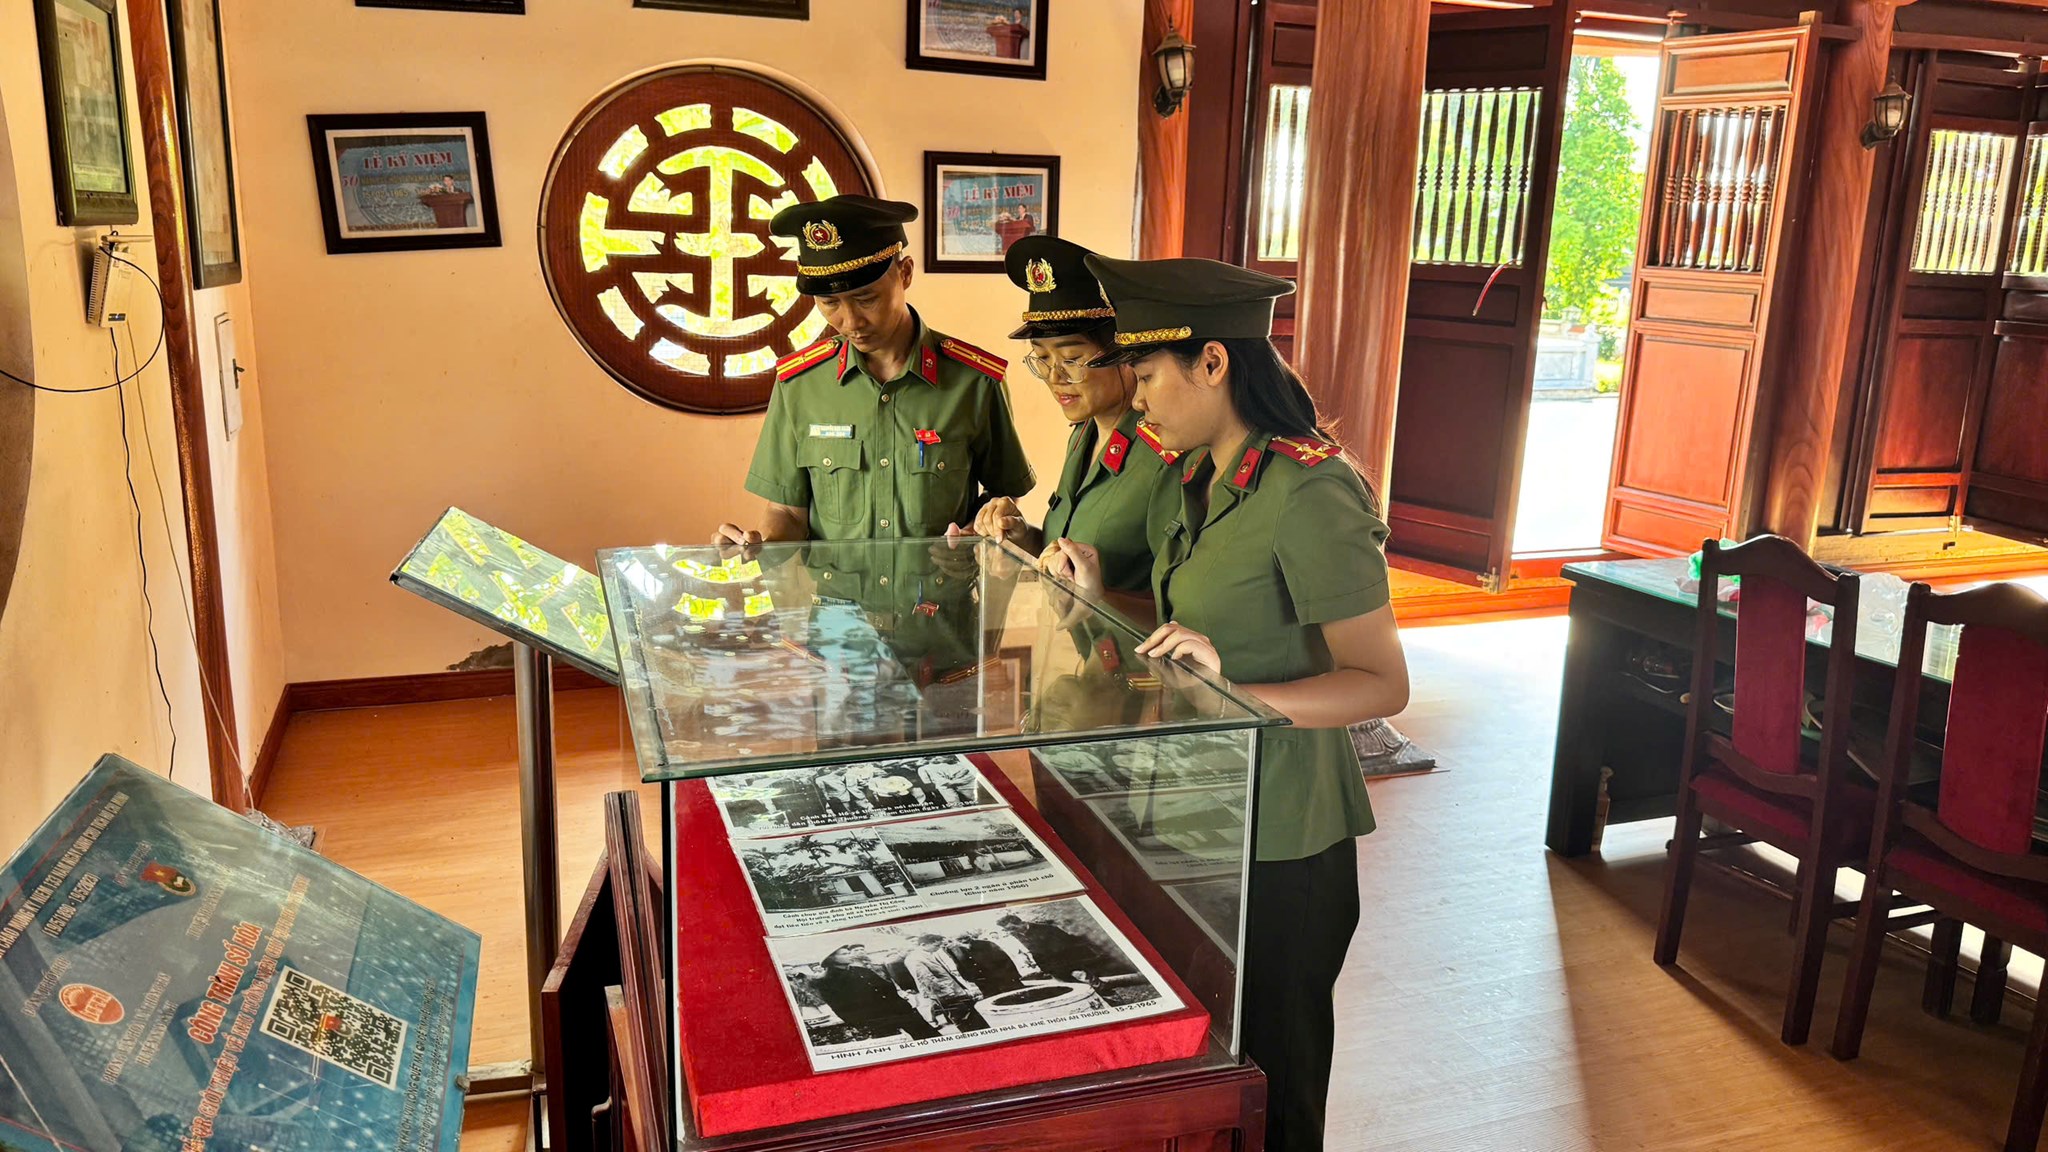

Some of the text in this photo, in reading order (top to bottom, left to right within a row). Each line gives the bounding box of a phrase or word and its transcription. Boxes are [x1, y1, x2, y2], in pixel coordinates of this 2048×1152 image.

[414, 150, 453, 168] NIỆM
[43, 874, 63, 890] 133
[254, 954, 279, 984] NIỆM
[187, 920, 263, 1044] CÔNG TRÌNH SỐ HÓA
[1114, 1000, 1157, 1013] 15-2-1965
[231, 1011, 255, 1040] KHU
[221, 1031, 246, 1053] VỀ
[830, 1050, 861, 1060] HÌNH
[208, 1049, 241, 1090] THIỆU
[199, 1087, 225, 1119] GIỚI
[189, 1116, 214, 1138] QR
